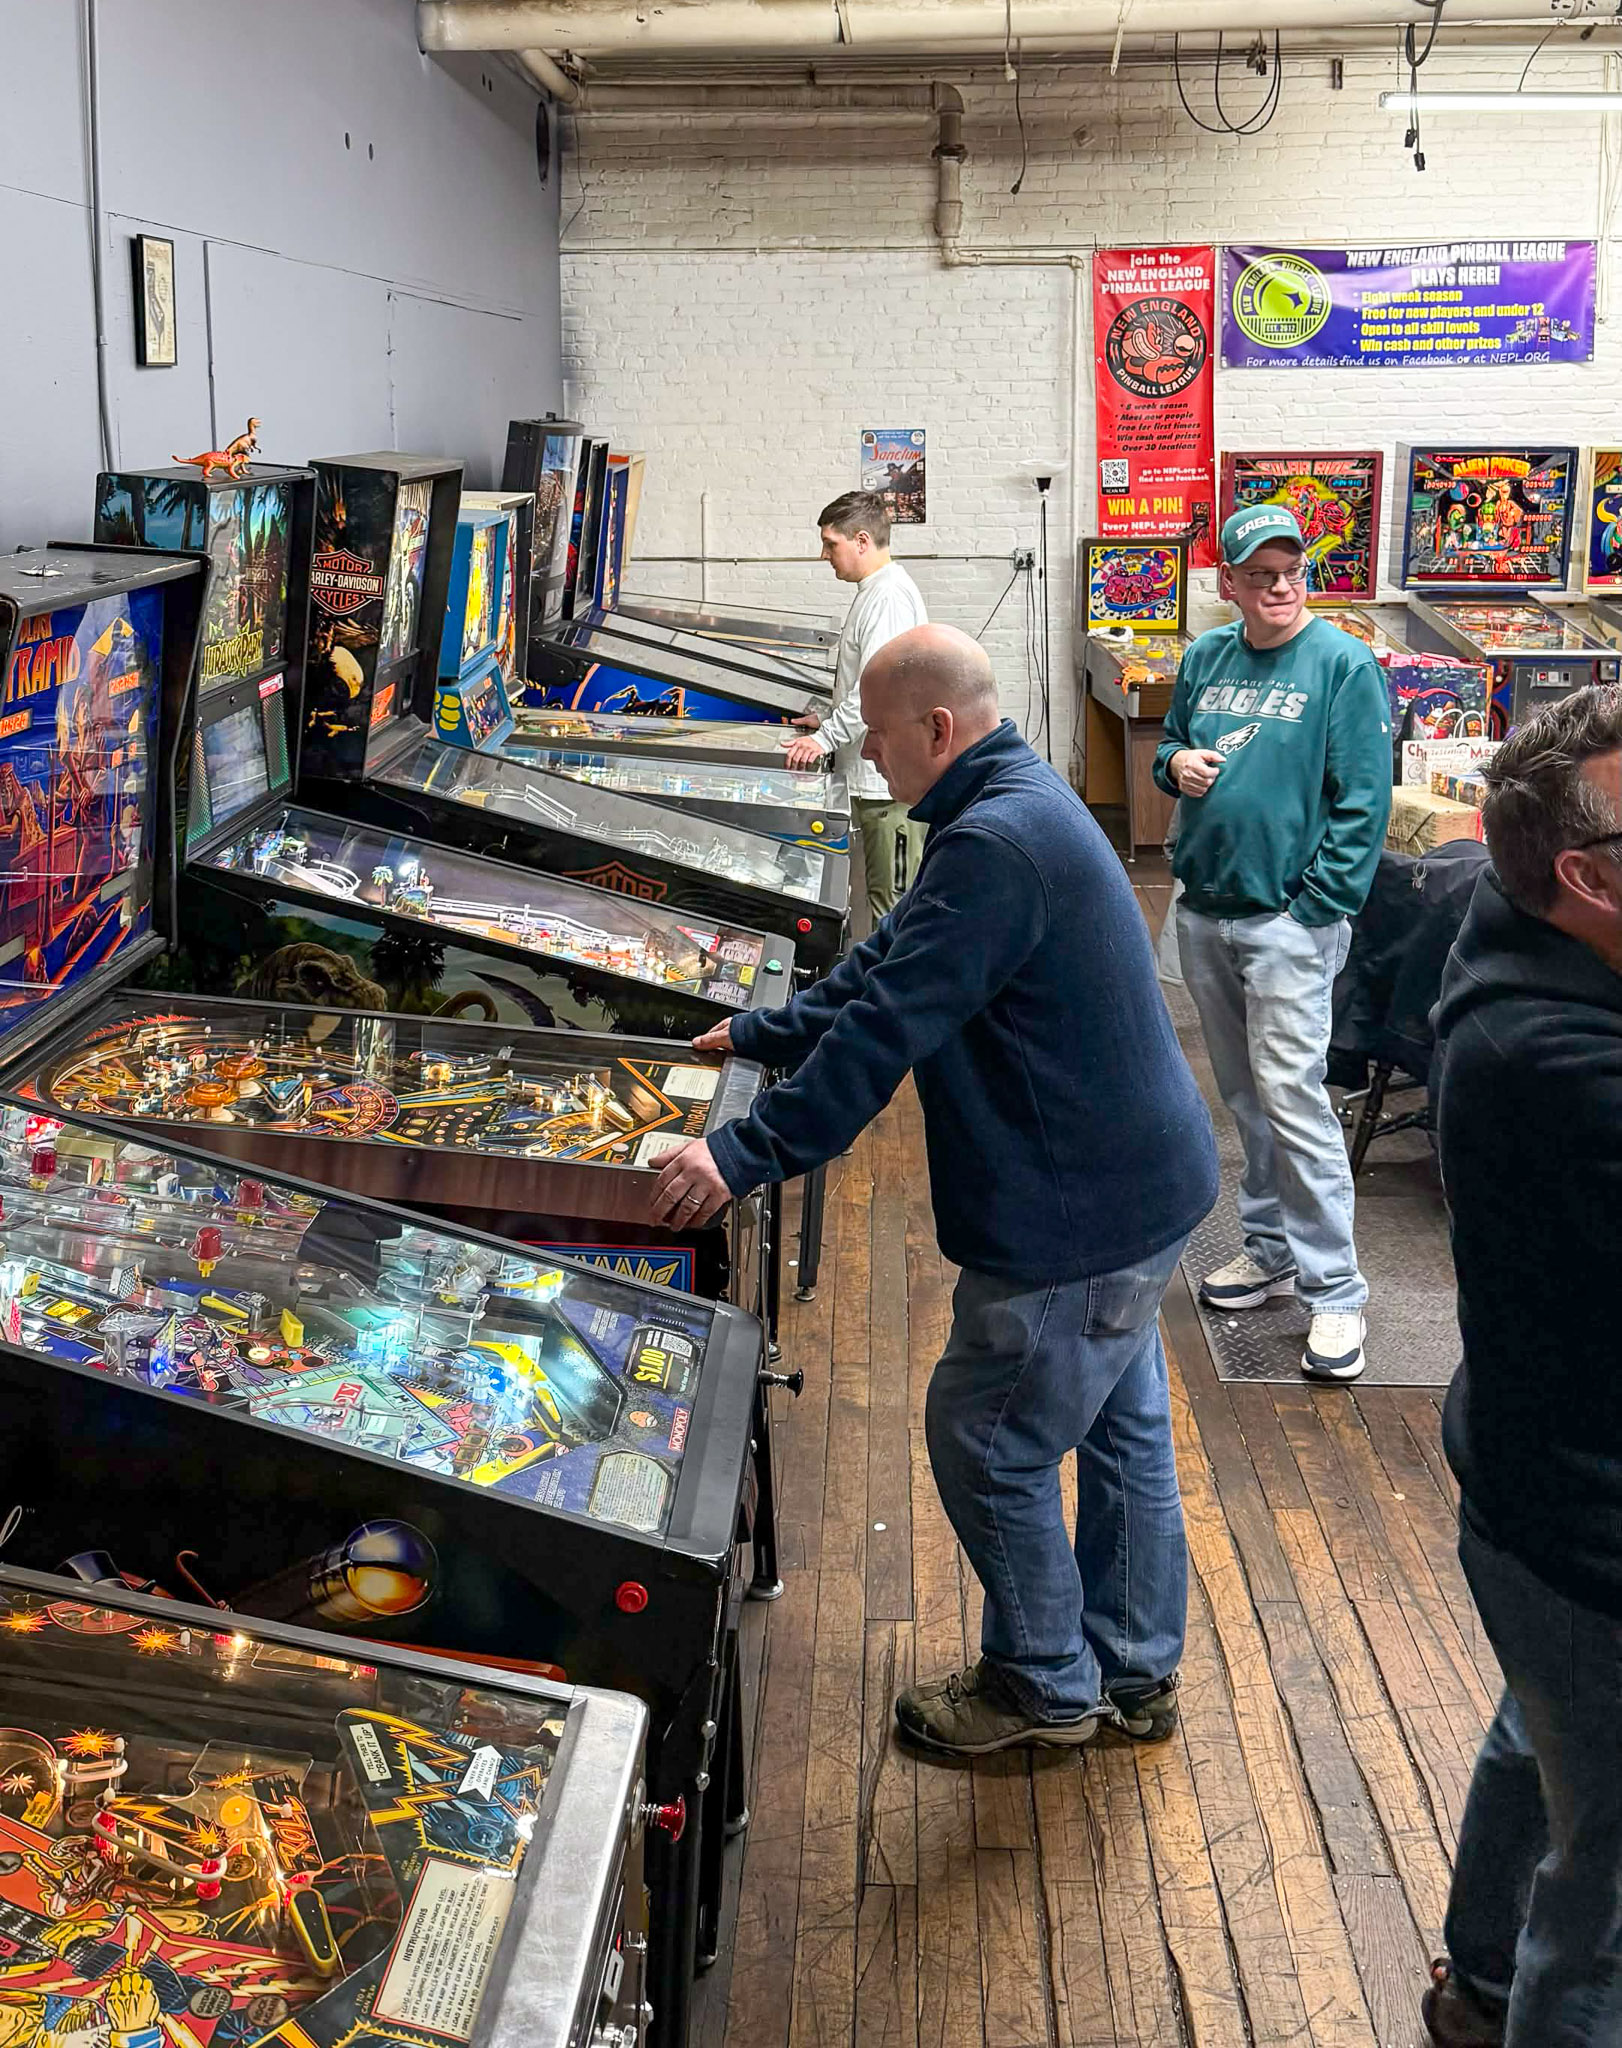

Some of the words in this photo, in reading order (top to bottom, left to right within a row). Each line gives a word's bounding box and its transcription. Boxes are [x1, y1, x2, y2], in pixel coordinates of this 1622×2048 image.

[1130, 254, 1156, 268] join
[1159, 252, 1181, 265] the
[1346, 251, 1383, 267] NEW
[1383, 246, 1449, 266] ENGLAND
[1451, 243, 1512, 263] PINBALL
[1512, 242, 1566, 262] LEAGUE
[1107, 269, 1137, 282] NEW
[1140, 266, 1204, 280] ENGLAND
[1411, 266, 1456, 287] PLAYS
[1458, 265, 1500, 286] HERE!
[1102, 282, 1157, 294] PINBALL
[1161, 279, 1210, 293] LEAGUE
[1361, 292, 1391, 304] Eight
[1392, 291, 1421, 303] week
[1423, 290, 1463, 302] season
[1361, 307, 1387, 320] Free
[1387, 307, 1404, 319] for
[1406, 307, 1428, 319] new
[1429, 305, 1471, 319] players
[1473, 305, 1495, 317] and
[1496, 303, 1530, 316] under
[1531, 303, 1544, 316] 12
[1111, 307, 1137, 340] NEW
[1139, 300, 1201, 338] ENGLAND
[1360, 323, 1390, 336] Open
[1391, 324, 1403, 335] to
[1404, 322, 1419, 335] all
[1420, 321, 1444, 334] skill
[1445, 320, 1480, 334] levels
[1359, 339, 1382, 352] Win
[1384, 338, 1411, 351] cash
[1412, 338, 1432, 351] and
[1435, 337, 1465, 350] other
[1466, 336, 1502, 350] prizes
[1246, 356, 1266, 367] For
[1268, 357, 1301, 367] more
[1368, 357, 1381, 365] us
[1384, 356, 1398, 366] on
[1402, 353, 1453, 366] Facebook
[1473, 354, 1486, 363] at
[1490, 351, 1550, 364] NEPL.ORG
[1115, 368, 1157, 395] PINBALL
[1160, 366, 1197, 395] LEAGUE
[1159, 402, 1188, 410] season
[1164, 412, 1194, 422] people
[1117, 424, 1136, 432] Free
[1138, 423, 1152, 431] for
[1153, 422, 1172, 431] first
[1173, 421, 1201, 430] timers
[1117, 434, 1133, 442] Win
[1135, 433, 1154, 441] cash
[1156, 433, 1173, 441] and
[1174, 432, 1202, 441] prizes
[1122, 444, 1142, 452] Over
[1144, 443, 1157, 451] 30
[1158, 443, 1197, 451] locations
[1255, 460, 1311, 476] SOLAR
[1313, 460, 1358, 475] RIDE
[1453, 457, 1490, 478] ALIEN
[1489, 456, 1531, 478] POKER
[1107, 498, 1136, 516] WIN
[1139, 497, 1150, 516] A
[1153, 496, 1183, 515] PIN!
[1102, 521, 1129, 532] Every
[1131, 521, 1157, 530] NEPL
[1159, 520, 1191, 531] player
[1235, 514, 1291, 540] EAGLES
[323, 557, 363, 573] MOTOR
[311, 571, 379, 592] ARLEY-DAVIDSON
[319, 589, 359, 607] CYCLES
[1197, 686, 1309, 718] EAGLES
[682, 1100, 710, 1136] PINBALL
[636, 1347, 666, 1383] $1.00
[671, 1408, 688, 1450] MONOPOLY
[367, 1740, 376, 1749] IT
[403, 1908, 428, 1963] INSTRUCTIONS
